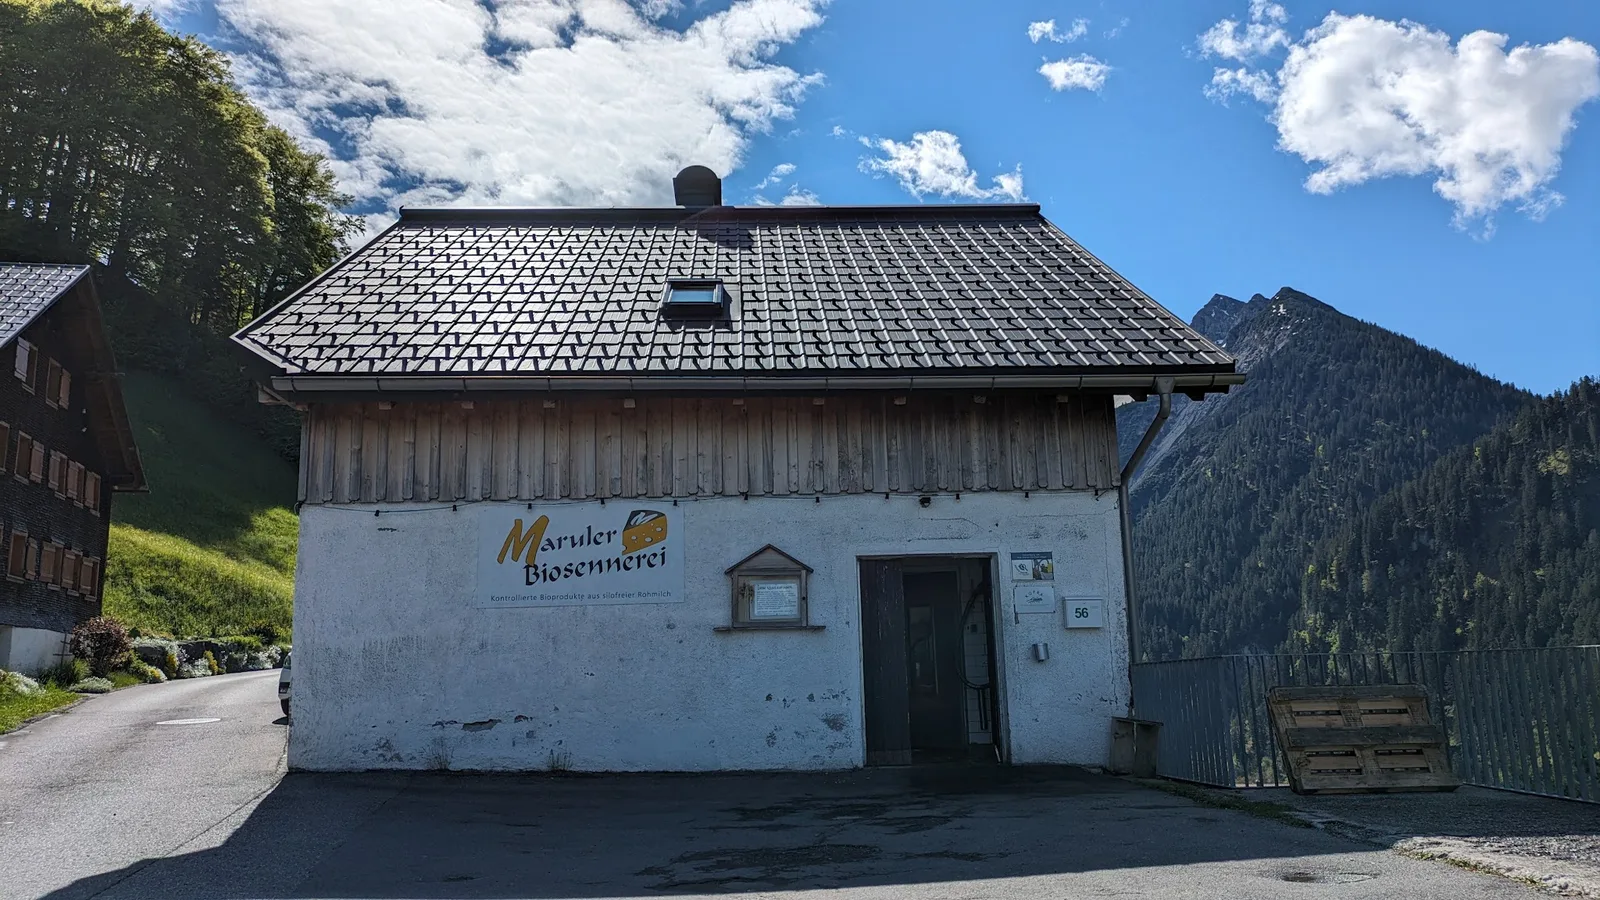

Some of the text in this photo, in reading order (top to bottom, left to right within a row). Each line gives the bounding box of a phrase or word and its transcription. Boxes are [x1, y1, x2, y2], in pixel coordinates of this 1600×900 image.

[497, 515, 617, 564] Maruler
[523, 546, 666, 585] Biosennerei
[490, 590, 671, 602] Kontrollierte Bioprodukte aus silofreier Rohmilch
[1074, 607, 1089, 619] 56
